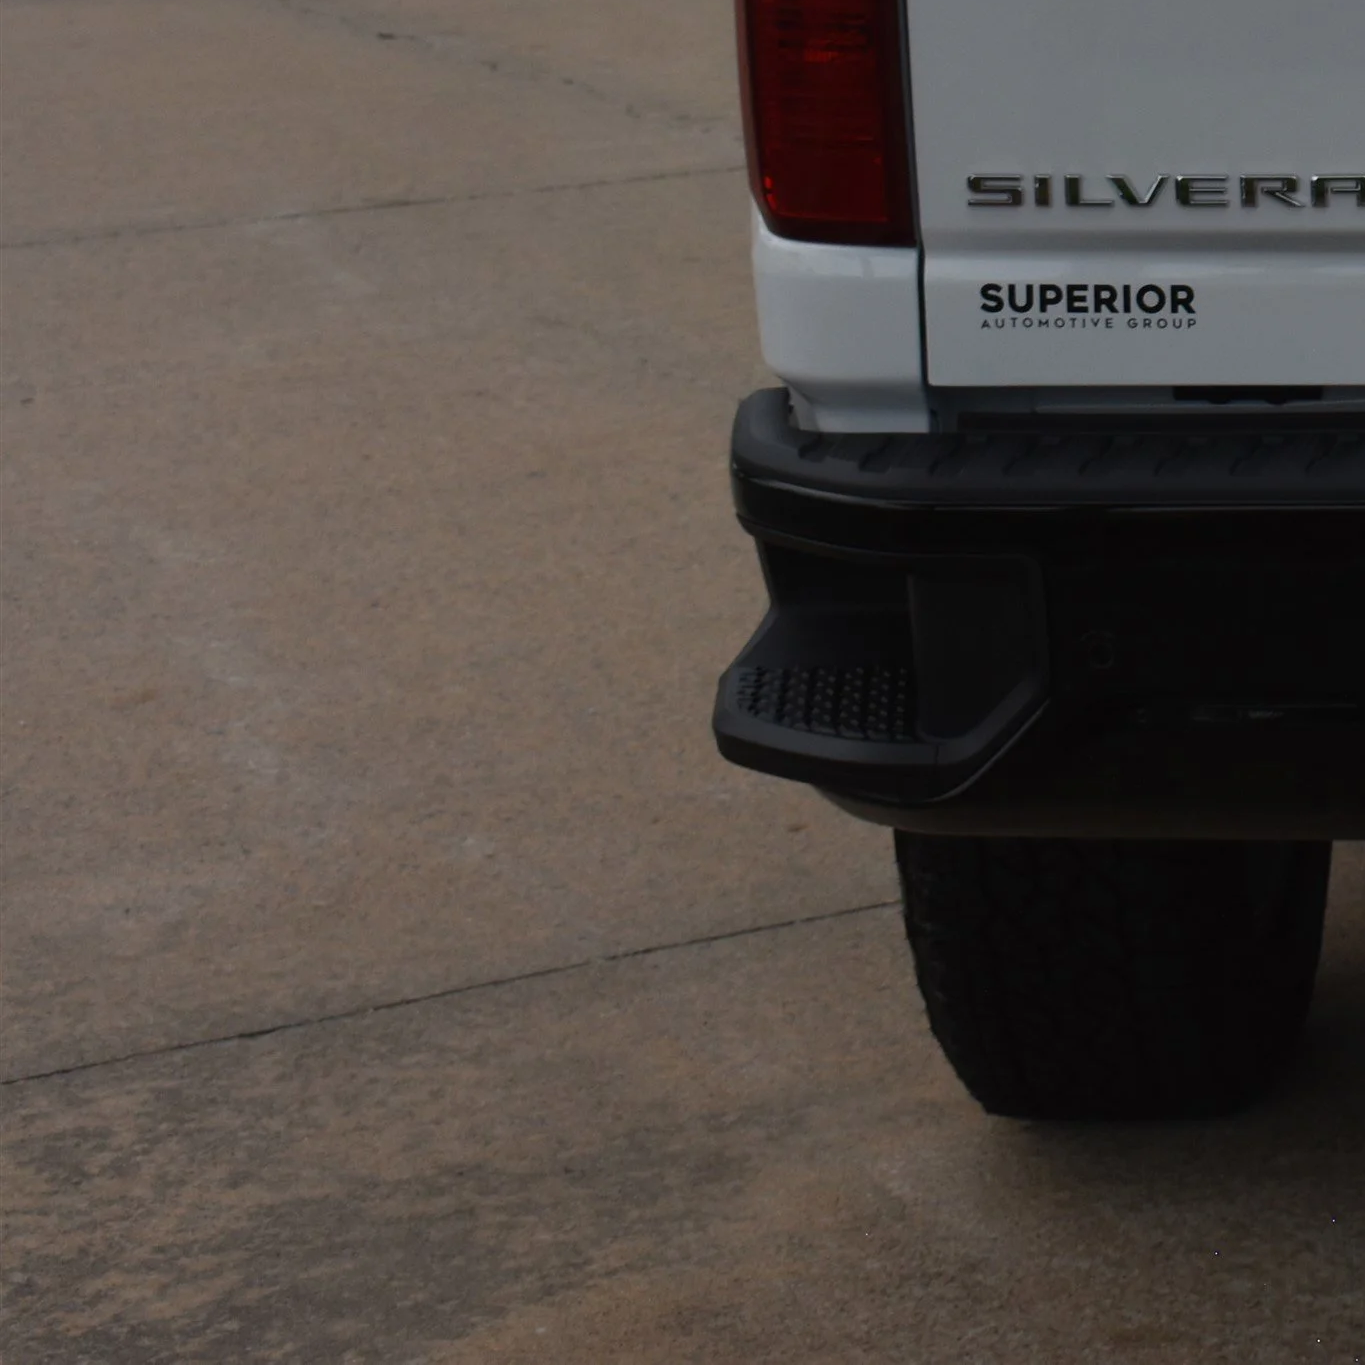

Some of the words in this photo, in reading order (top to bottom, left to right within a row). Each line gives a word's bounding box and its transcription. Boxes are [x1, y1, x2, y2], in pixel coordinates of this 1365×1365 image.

[979, 282, 1197, 314] SUPERIOR
[980, 317, 1114, 329] AUTOMOTIVE
[1127, 317, 1197, 329] GROUP
